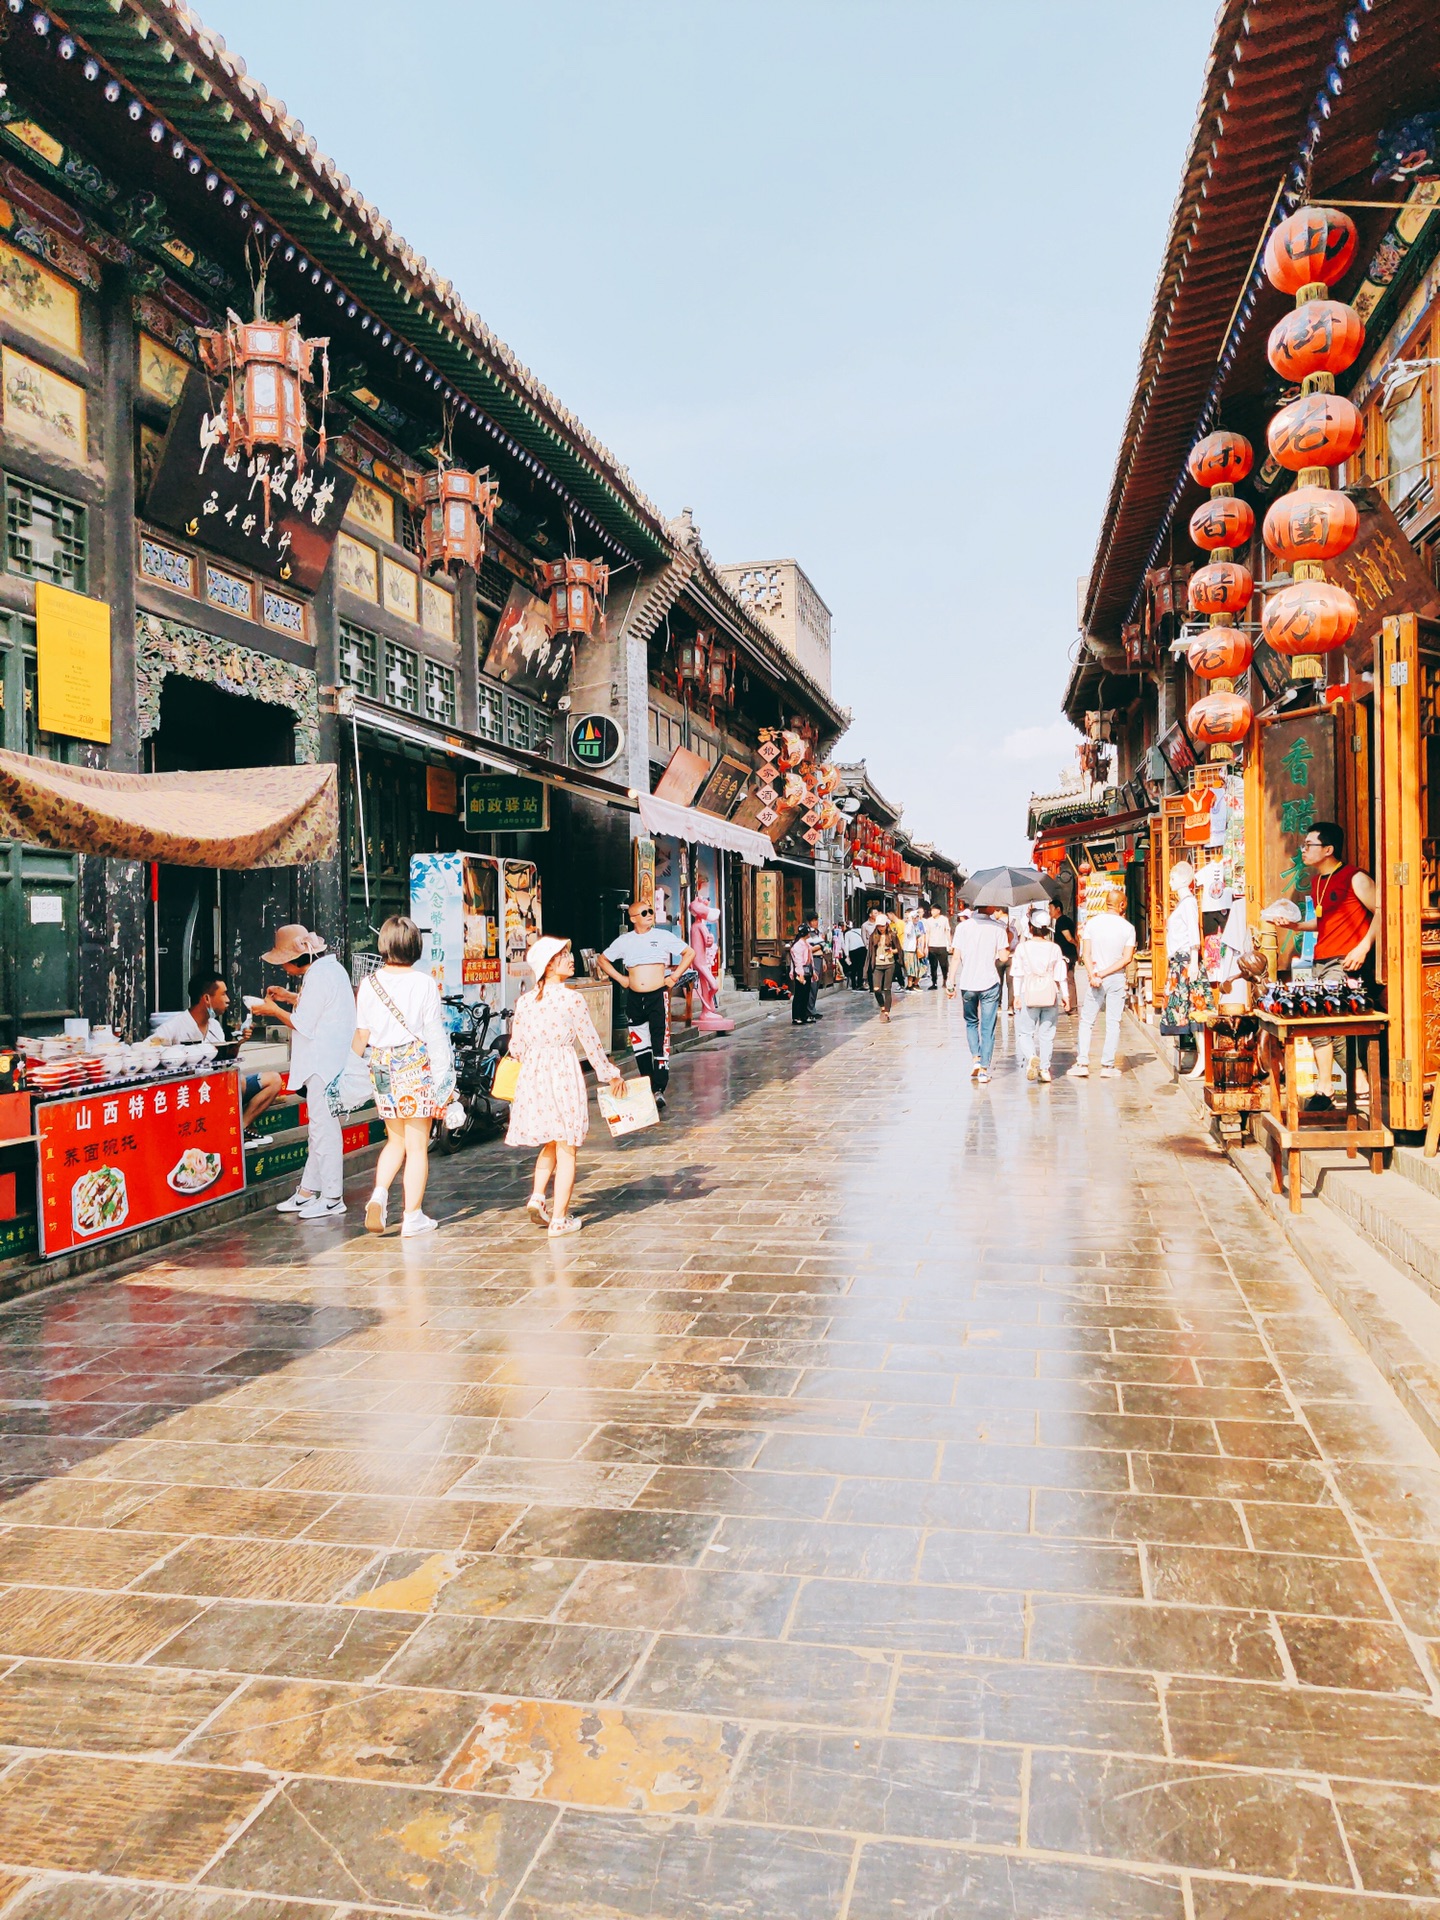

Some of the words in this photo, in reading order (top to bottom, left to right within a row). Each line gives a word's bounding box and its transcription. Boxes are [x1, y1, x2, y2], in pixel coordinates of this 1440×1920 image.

[76, 1081, 212, 1131] 山西特色美食
[177, 1117, 207, 1138] 凉皮
